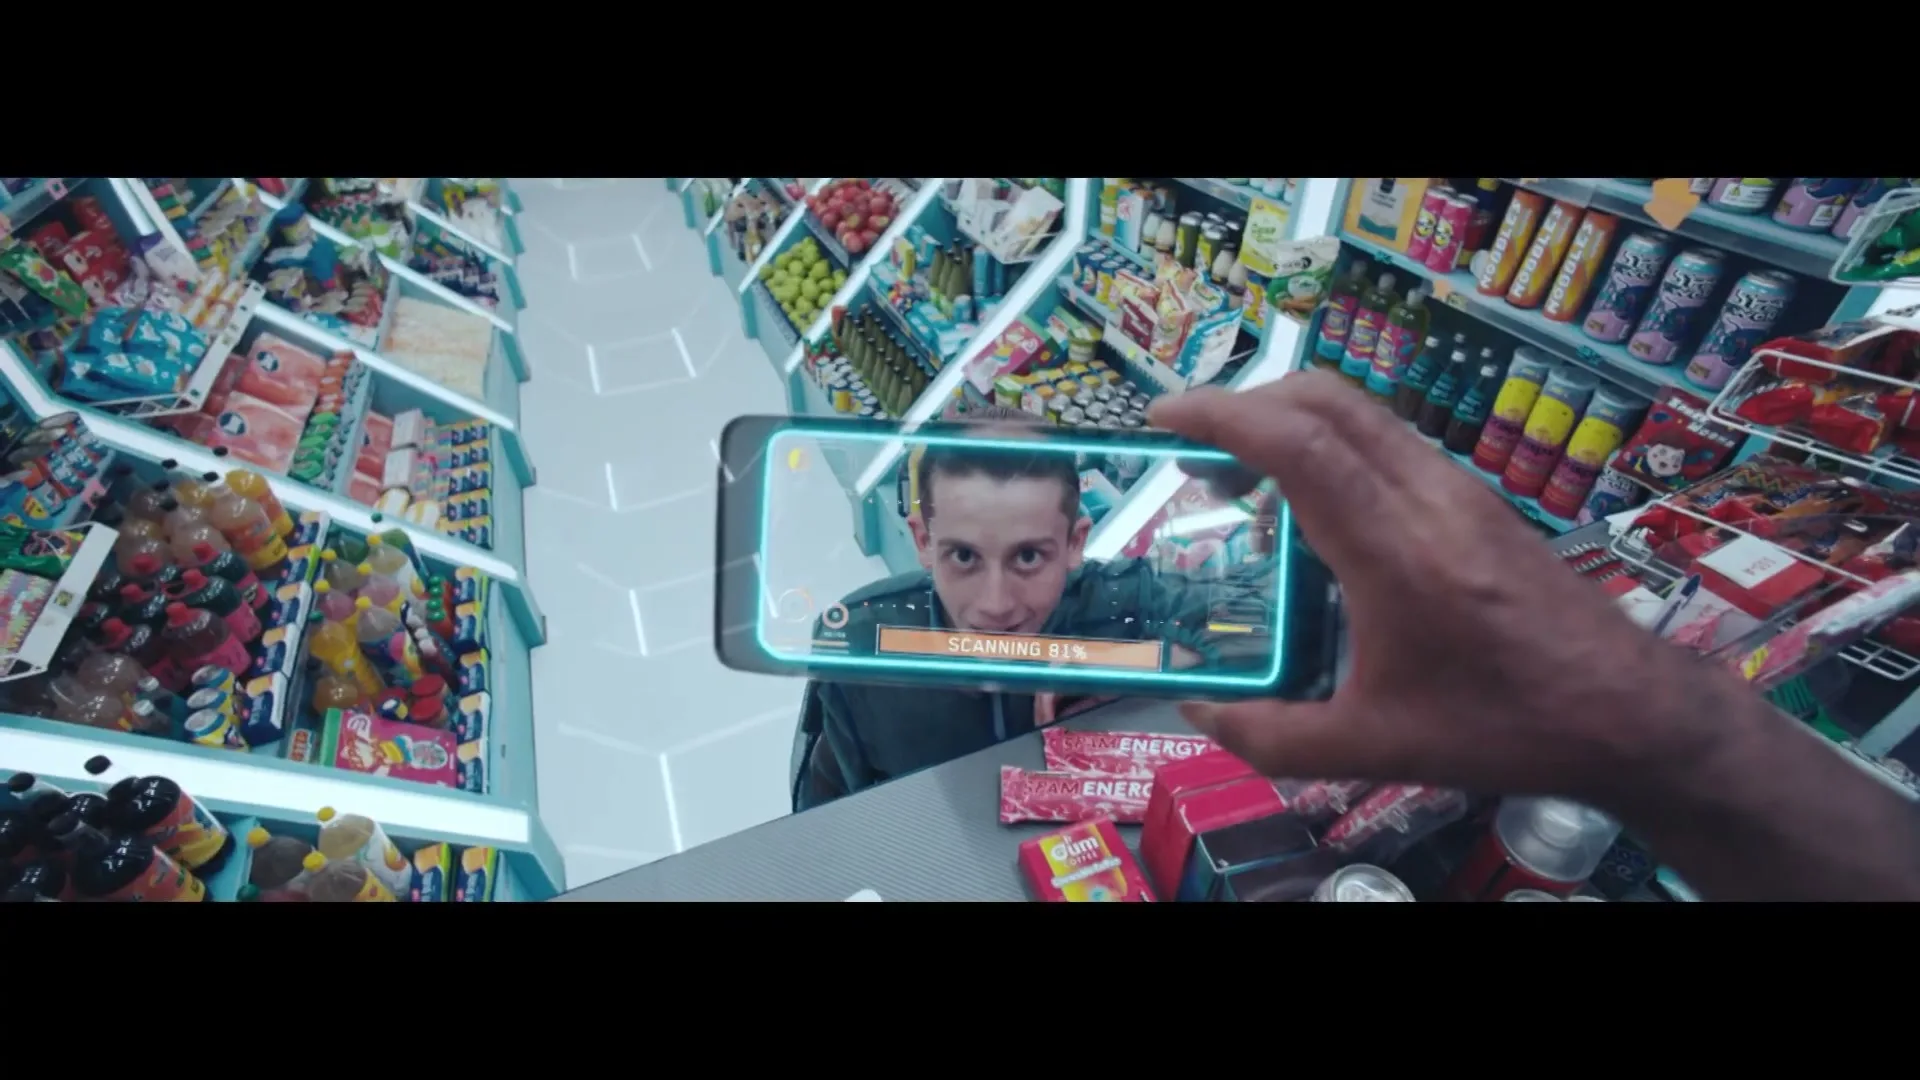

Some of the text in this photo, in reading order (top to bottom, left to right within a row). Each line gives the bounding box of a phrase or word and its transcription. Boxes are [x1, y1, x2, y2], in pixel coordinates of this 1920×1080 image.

[948, 637, 1088, 660] SCANNING 81%
[1119, 736, 1207, 757] ENERGY
[1082, 780, 1153, 797] ENERG
